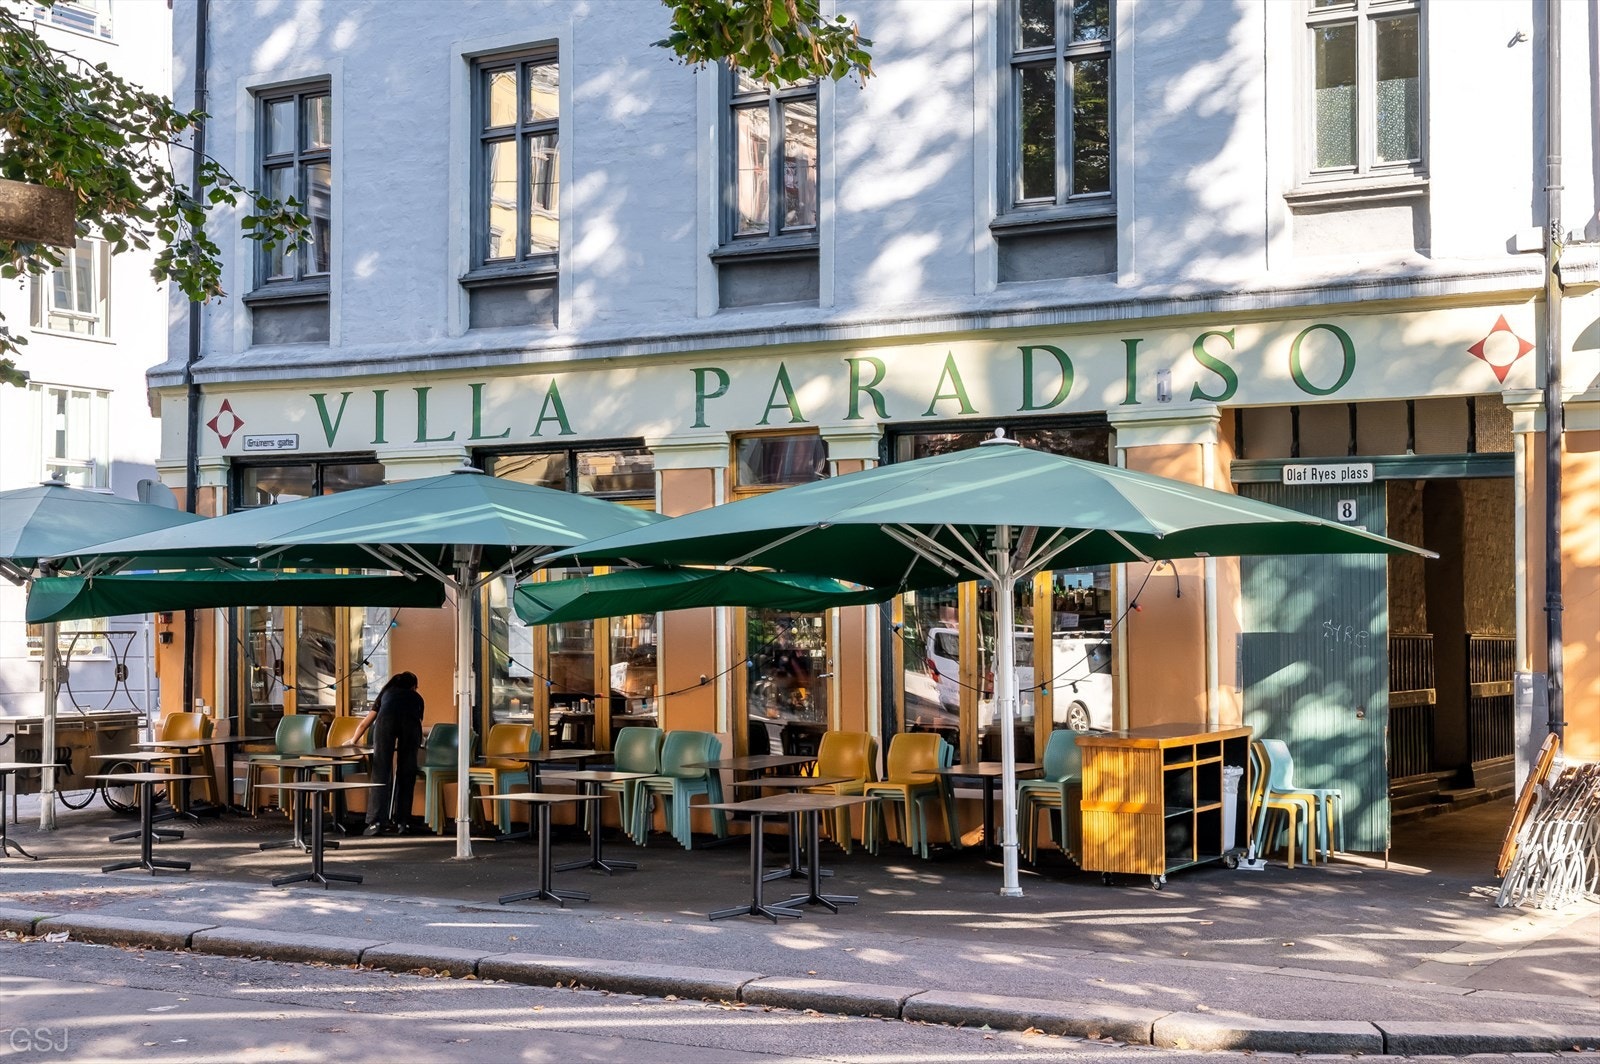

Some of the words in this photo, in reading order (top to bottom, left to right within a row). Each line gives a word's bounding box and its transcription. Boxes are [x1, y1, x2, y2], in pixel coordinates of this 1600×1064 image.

[309, 377, 578, 449] VILLA
[689, 323, 1357, 429] PARADISO
[1287, 468, 1307, 481] Olaf
[1311, 466, 1336, 482] Ryes
[1341, 467, 1368, 481] plass
[1342, 502, 1352, 518] 8
